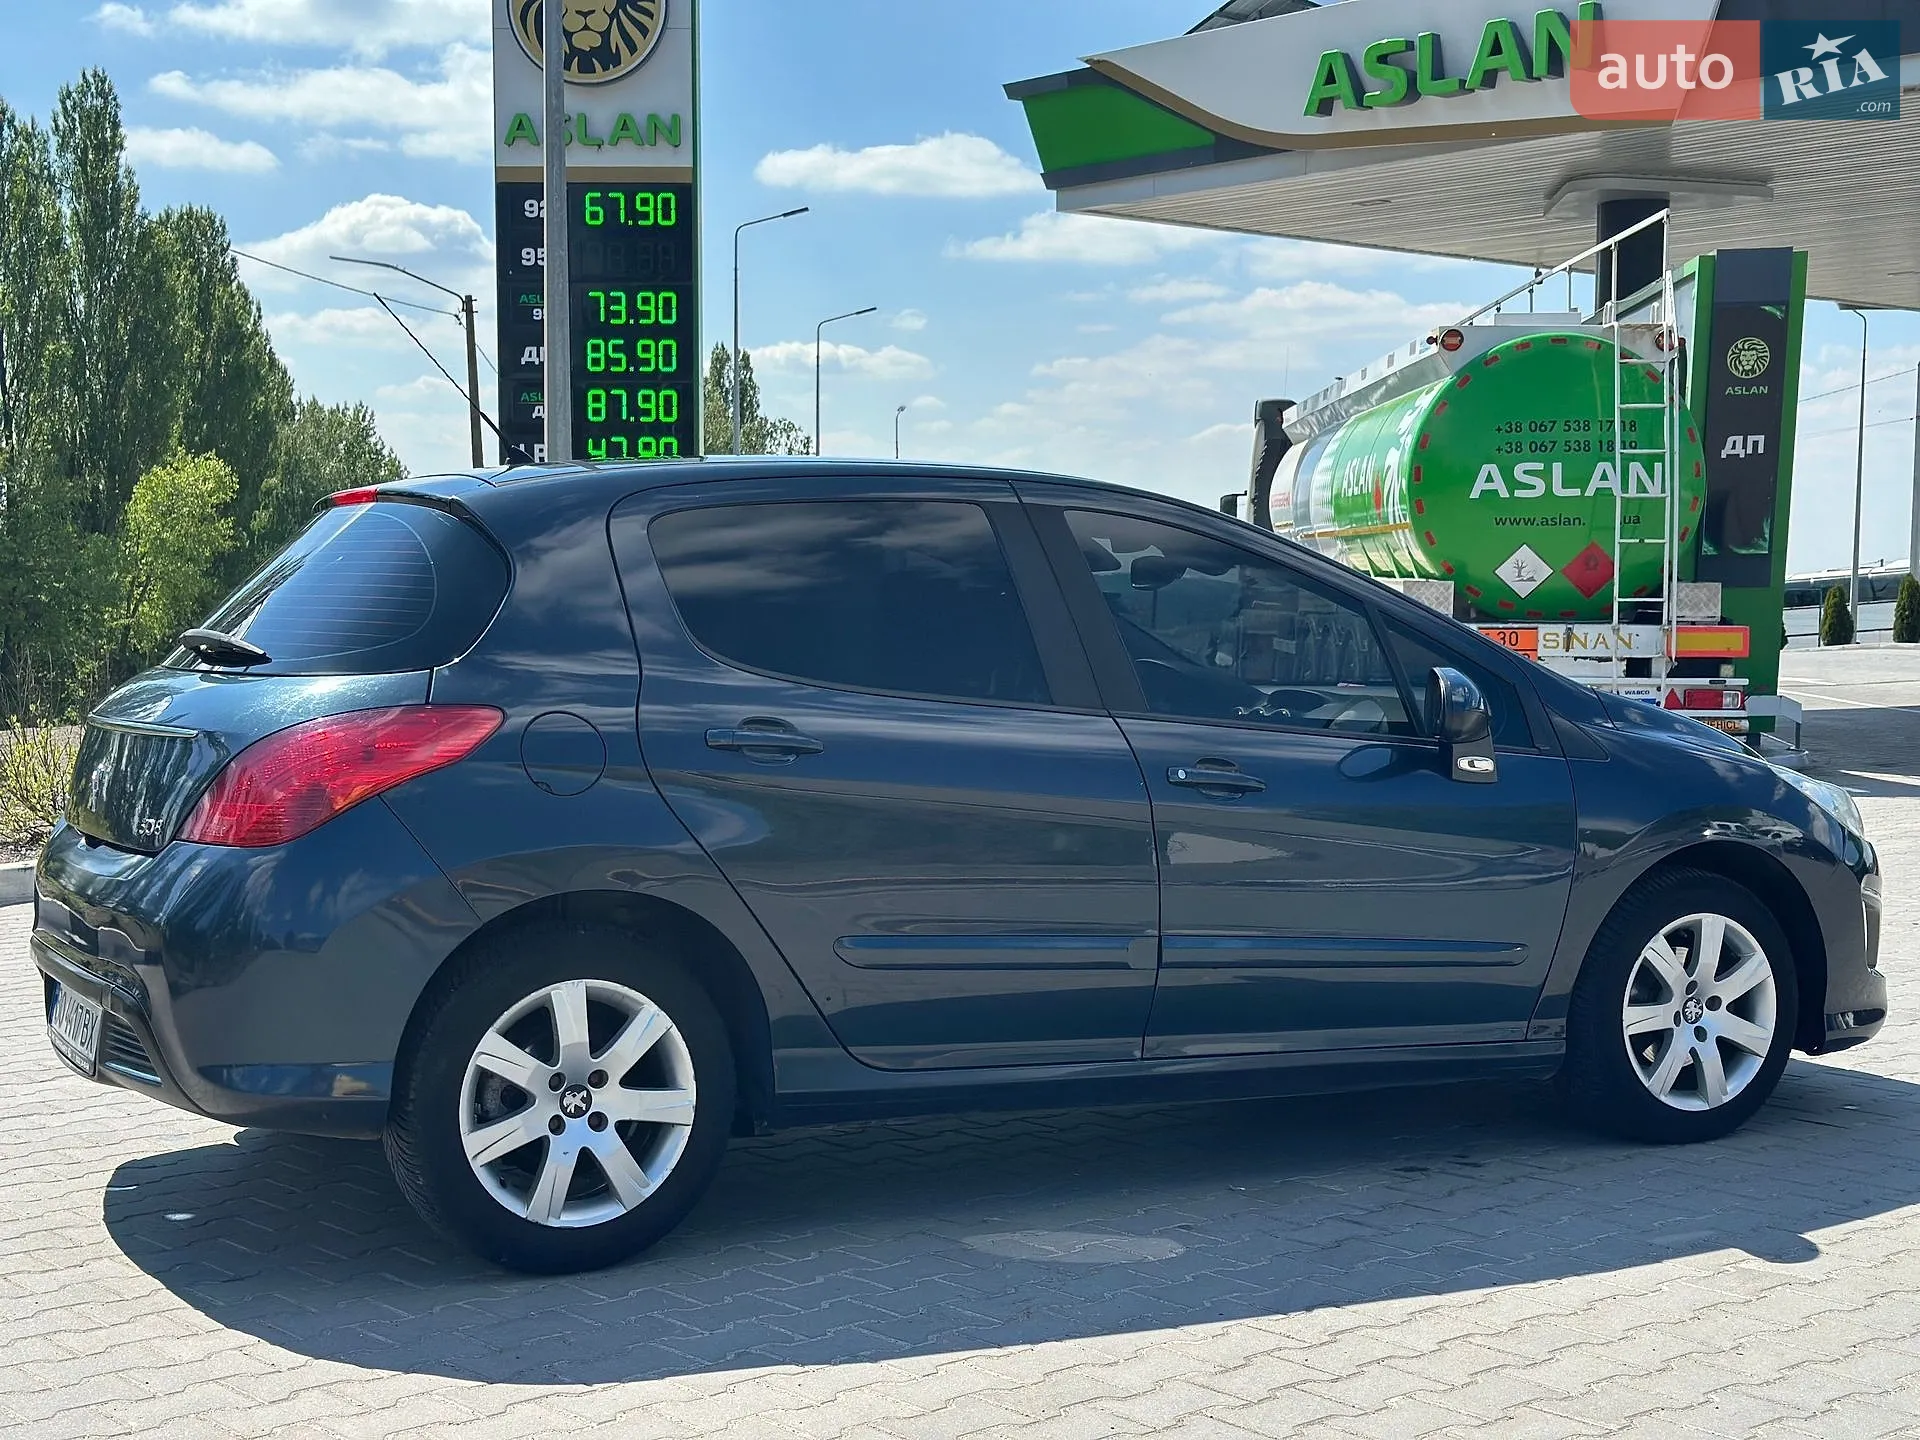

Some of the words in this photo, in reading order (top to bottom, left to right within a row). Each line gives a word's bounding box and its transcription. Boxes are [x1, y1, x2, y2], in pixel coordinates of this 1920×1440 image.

[1303, 1, 1600, 117] ASLAN
[585, 192, 676, 226] 67.90
[532, 308, 544, 320] 9
[588, 291, 677, 325] 73.90
[587, 339, 677, 372] 85.90
[587, 389, 678, 423] 87.90
[1725, 386, 1769, 395] ASLAN
[1495, 420, 1523, 434] +38
[1528, 420, 1558, 433] 067
[1562, 419, 1591, 432] 538
[1495, 440, 1523, 454] +38
[1528, 440, 1558, 453] 067
[1563, 440, 1591, 453] 538
[1720, 434, 1765, 459] ДП
[1342, 454, 1376, 497] ASLAN
[1469, 461, 1662, 499] ASLAN
